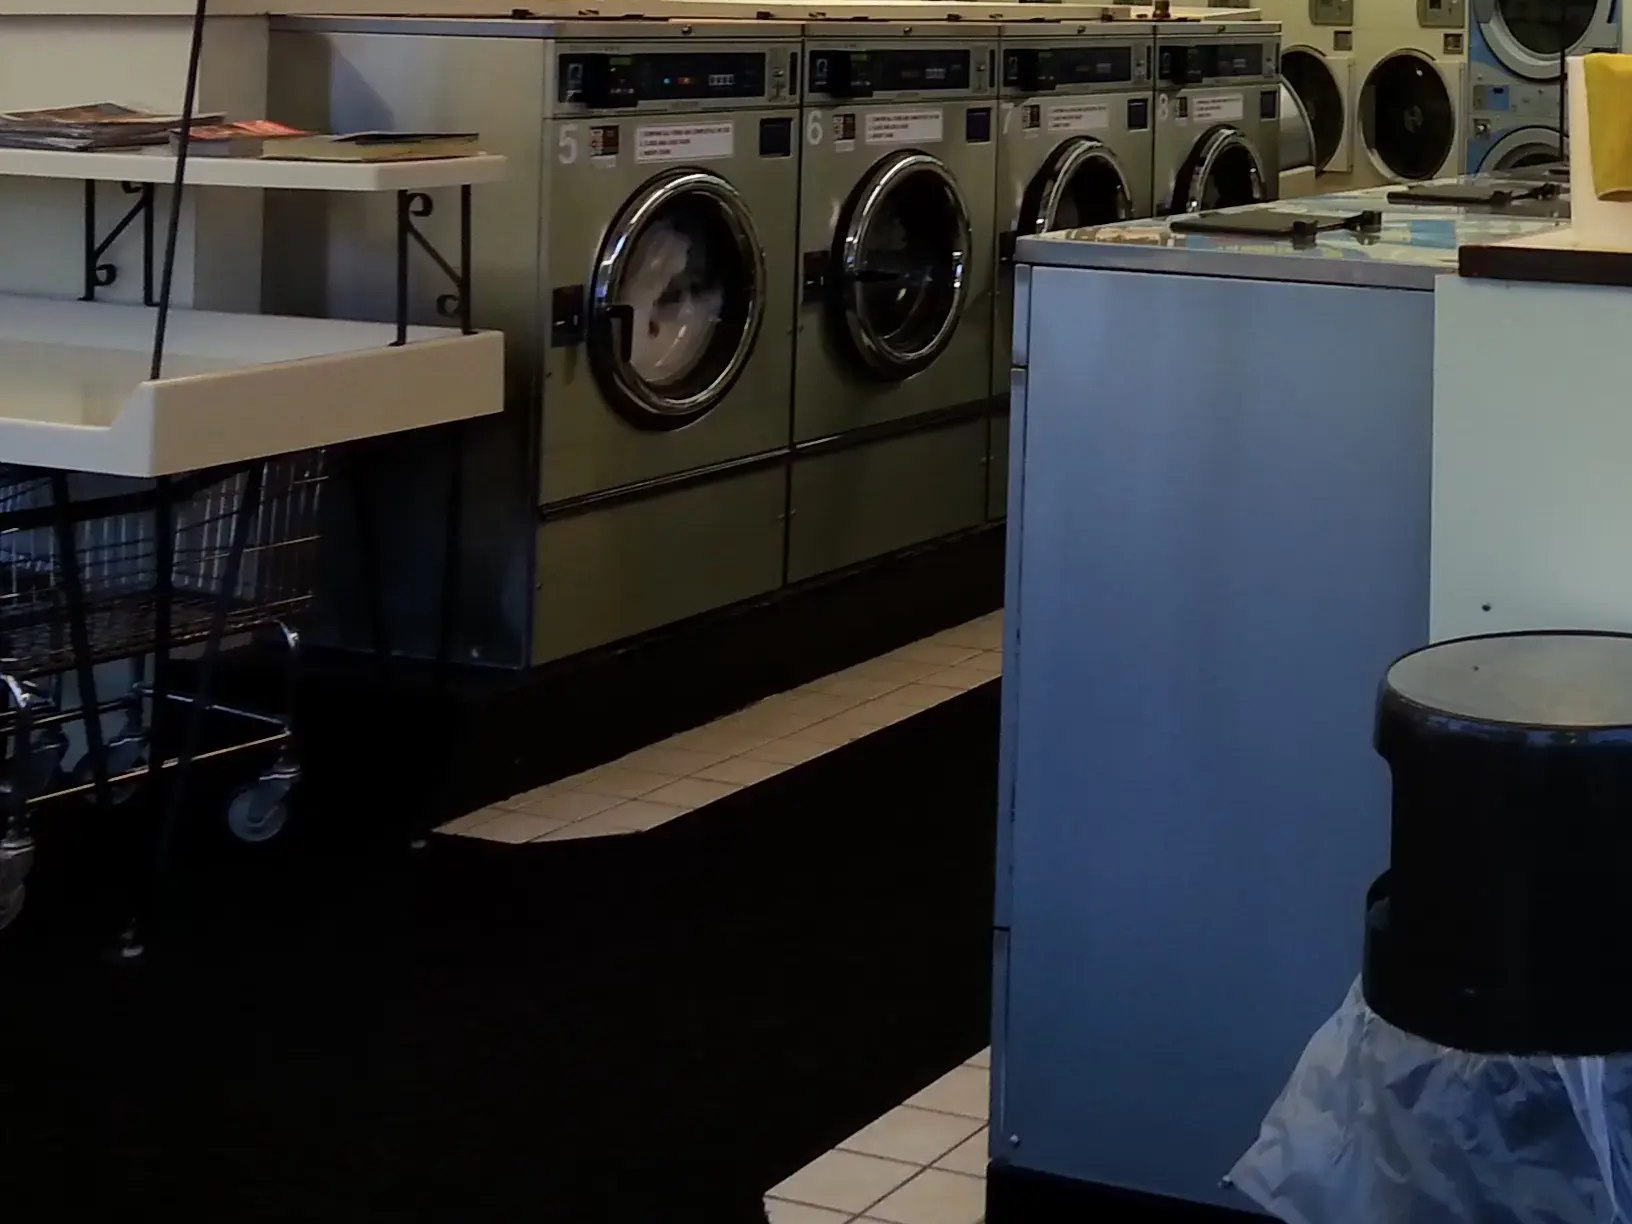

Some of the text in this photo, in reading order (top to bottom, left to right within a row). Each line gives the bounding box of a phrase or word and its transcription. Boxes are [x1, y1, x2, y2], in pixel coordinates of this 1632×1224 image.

[1000, 103, 1014, 135] 7
[1158, 93, 1169, 121] 8
[558, 125, 579, 164] 5
[812, 111, 828, 146] 6
